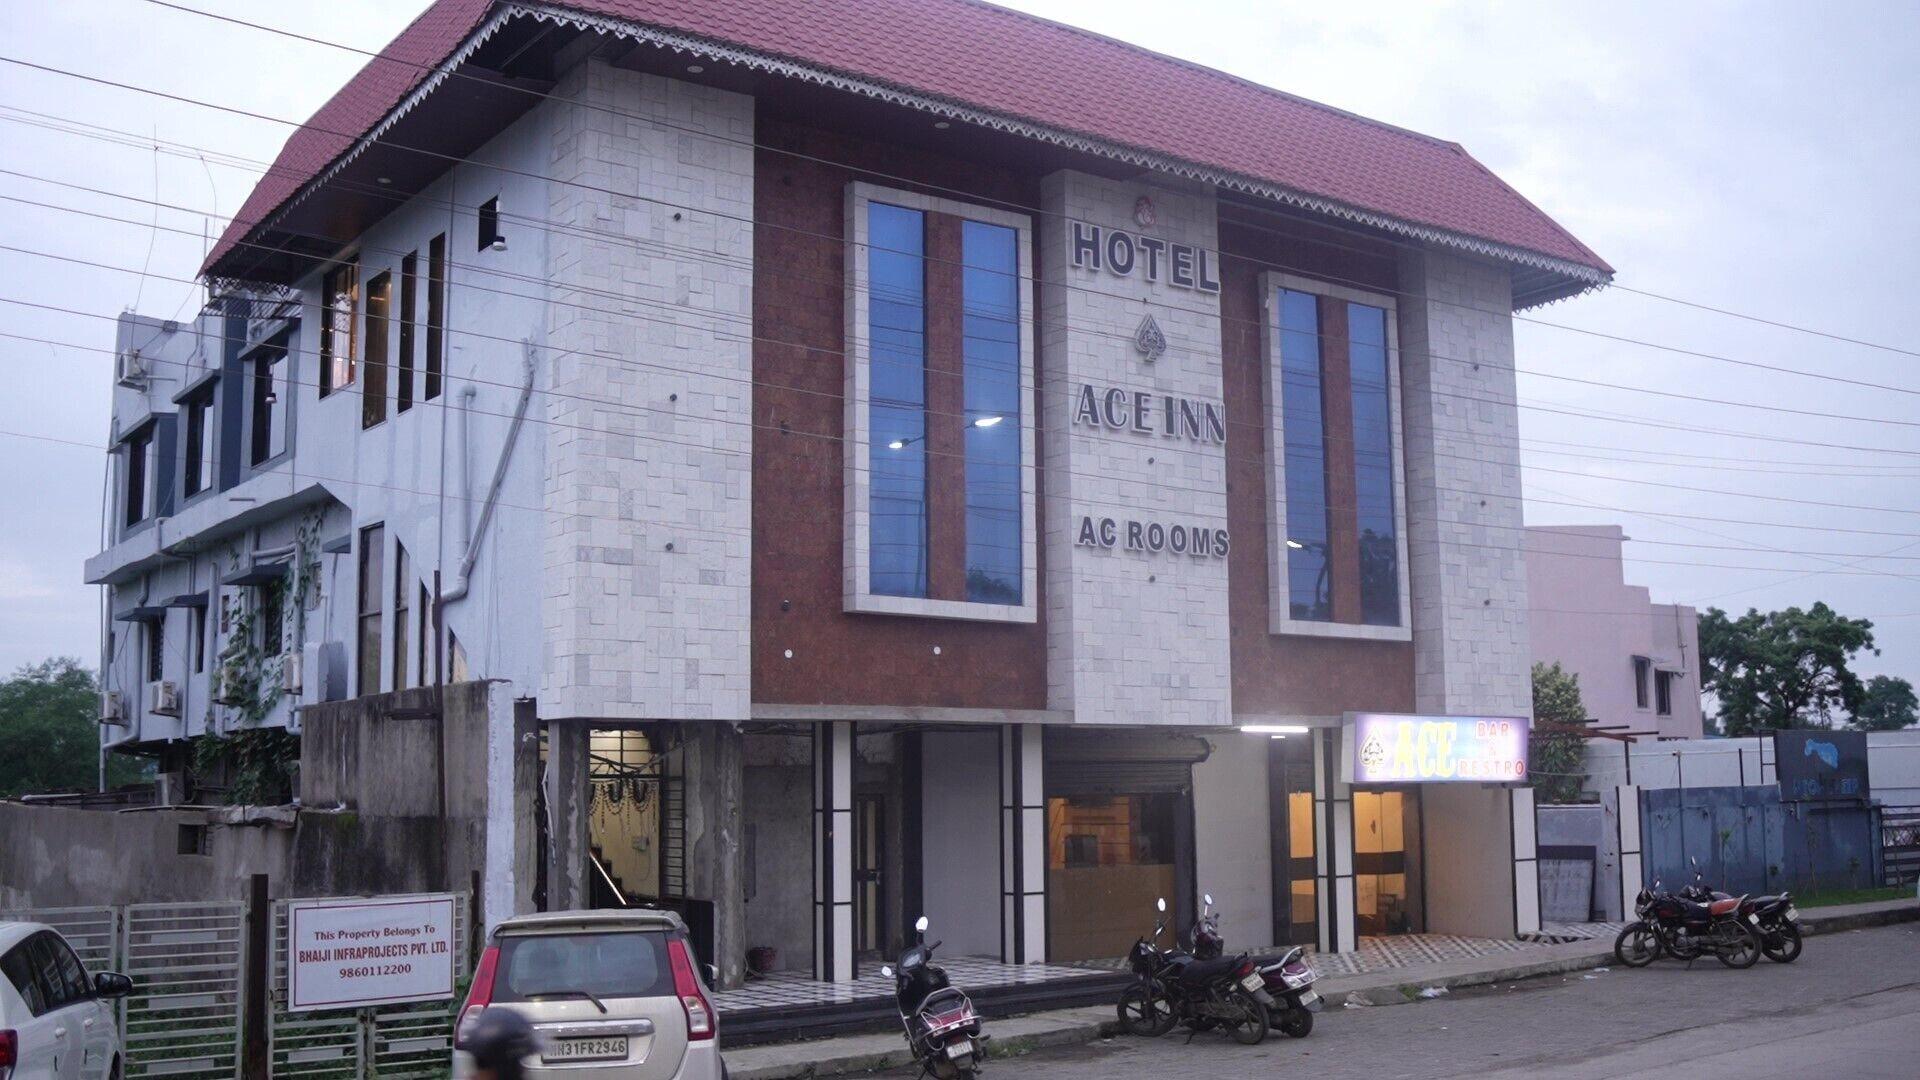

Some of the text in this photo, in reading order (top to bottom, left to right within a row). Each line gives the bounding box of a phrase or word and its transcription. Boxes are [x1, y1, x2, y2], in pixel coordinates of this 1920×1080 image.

[1071, 222, 1221, 293] HOTEL
[1073, 383, 1227, 444] ACE INN
[1077, 516, 1231, 558] AC ROOMS
[1476, 721, 1511, 739] BAR
[1391, 720, 1457, 778] ACE
[1458, 759, 1526, 778] RESTRO
[314, 925, 436, 941] This Property Belongs To
[299, 940, 449, 964] BHAIJI INFRAPROJECTS PVT. LTD.
[339, 963, 412, 979] 9860112200
